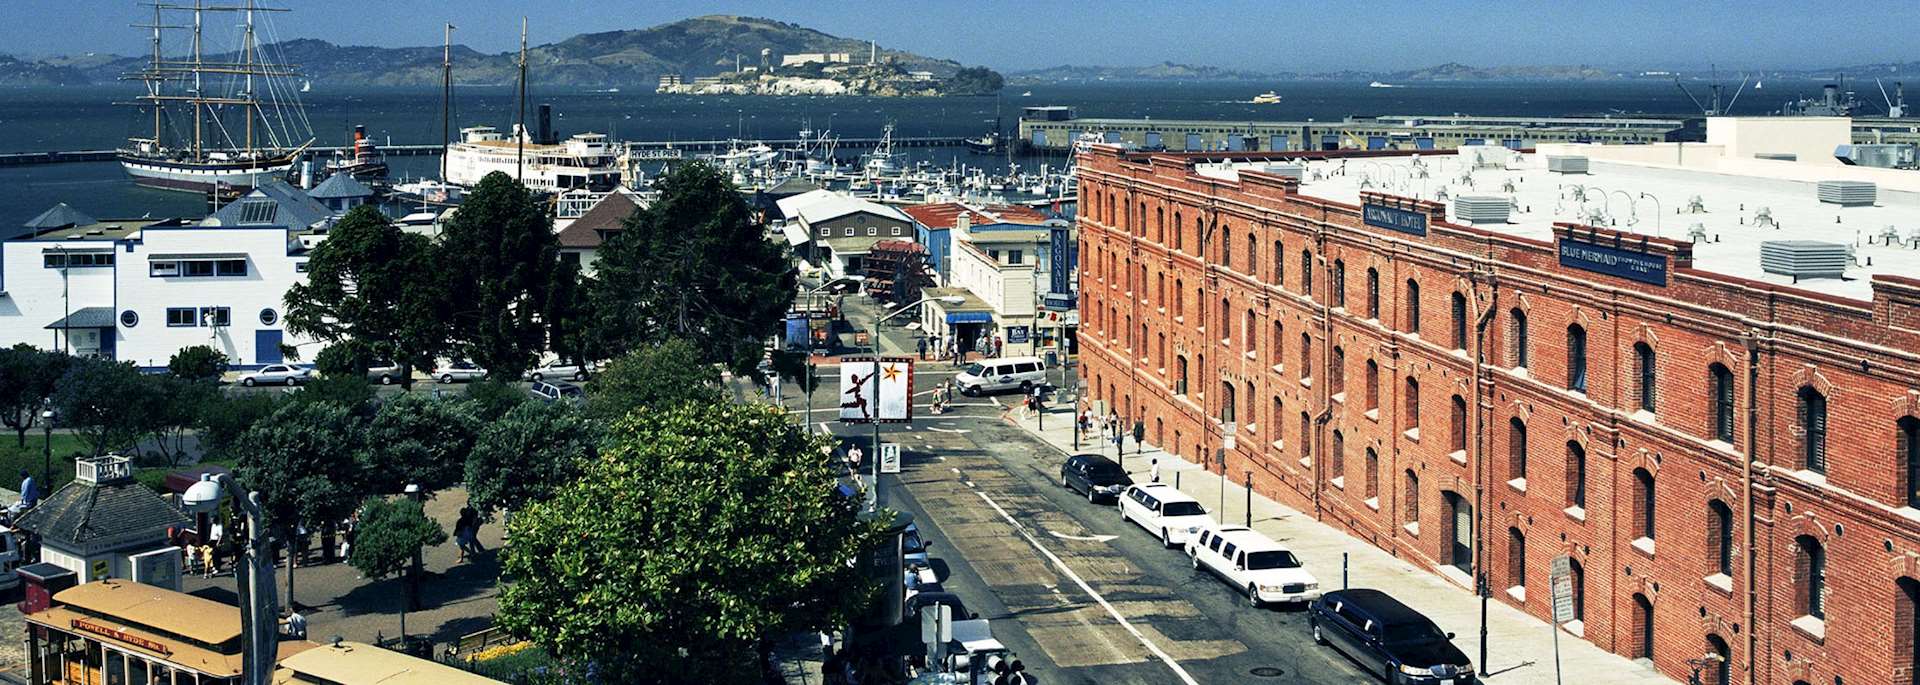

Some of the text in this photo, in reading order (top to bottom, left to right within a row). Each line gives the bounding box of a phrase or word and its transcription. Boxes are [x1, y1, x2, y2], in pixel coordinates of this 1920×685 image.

[632, 150, 651, 158] HYDE
[1561, 246, 1618, 266] BLUE MERMAID
[79, 621, 110, 635] POWELL
[122, 633, 145, 646] HYDE
